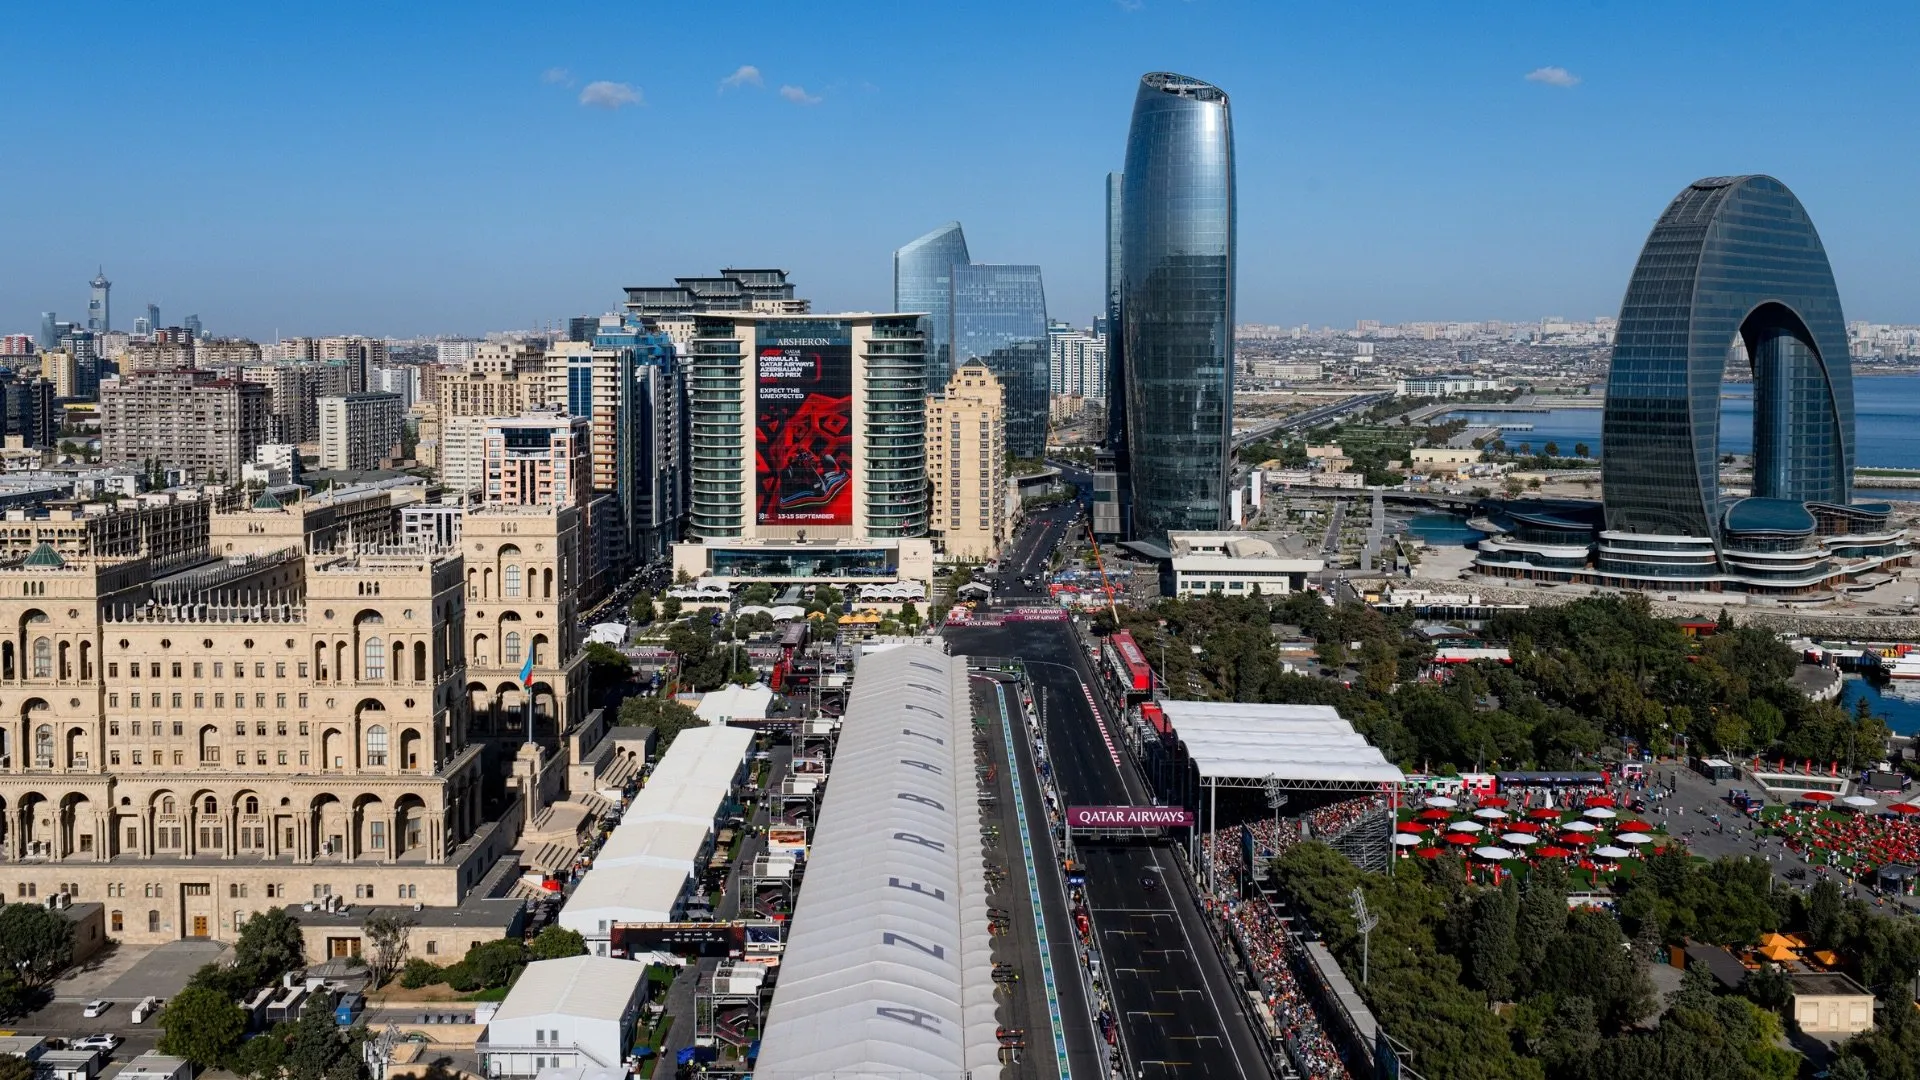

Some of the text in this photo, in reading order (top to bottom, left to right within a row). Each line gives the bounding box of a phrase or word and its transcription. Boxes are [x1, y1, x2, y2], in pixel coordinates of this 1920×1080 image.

[777, 338, 830, 346] ABSHERON
[1080, 811, 1184, 824] QATAR AIRWAYS
[876, 660, 946, 1035] AZERBAIJAN
